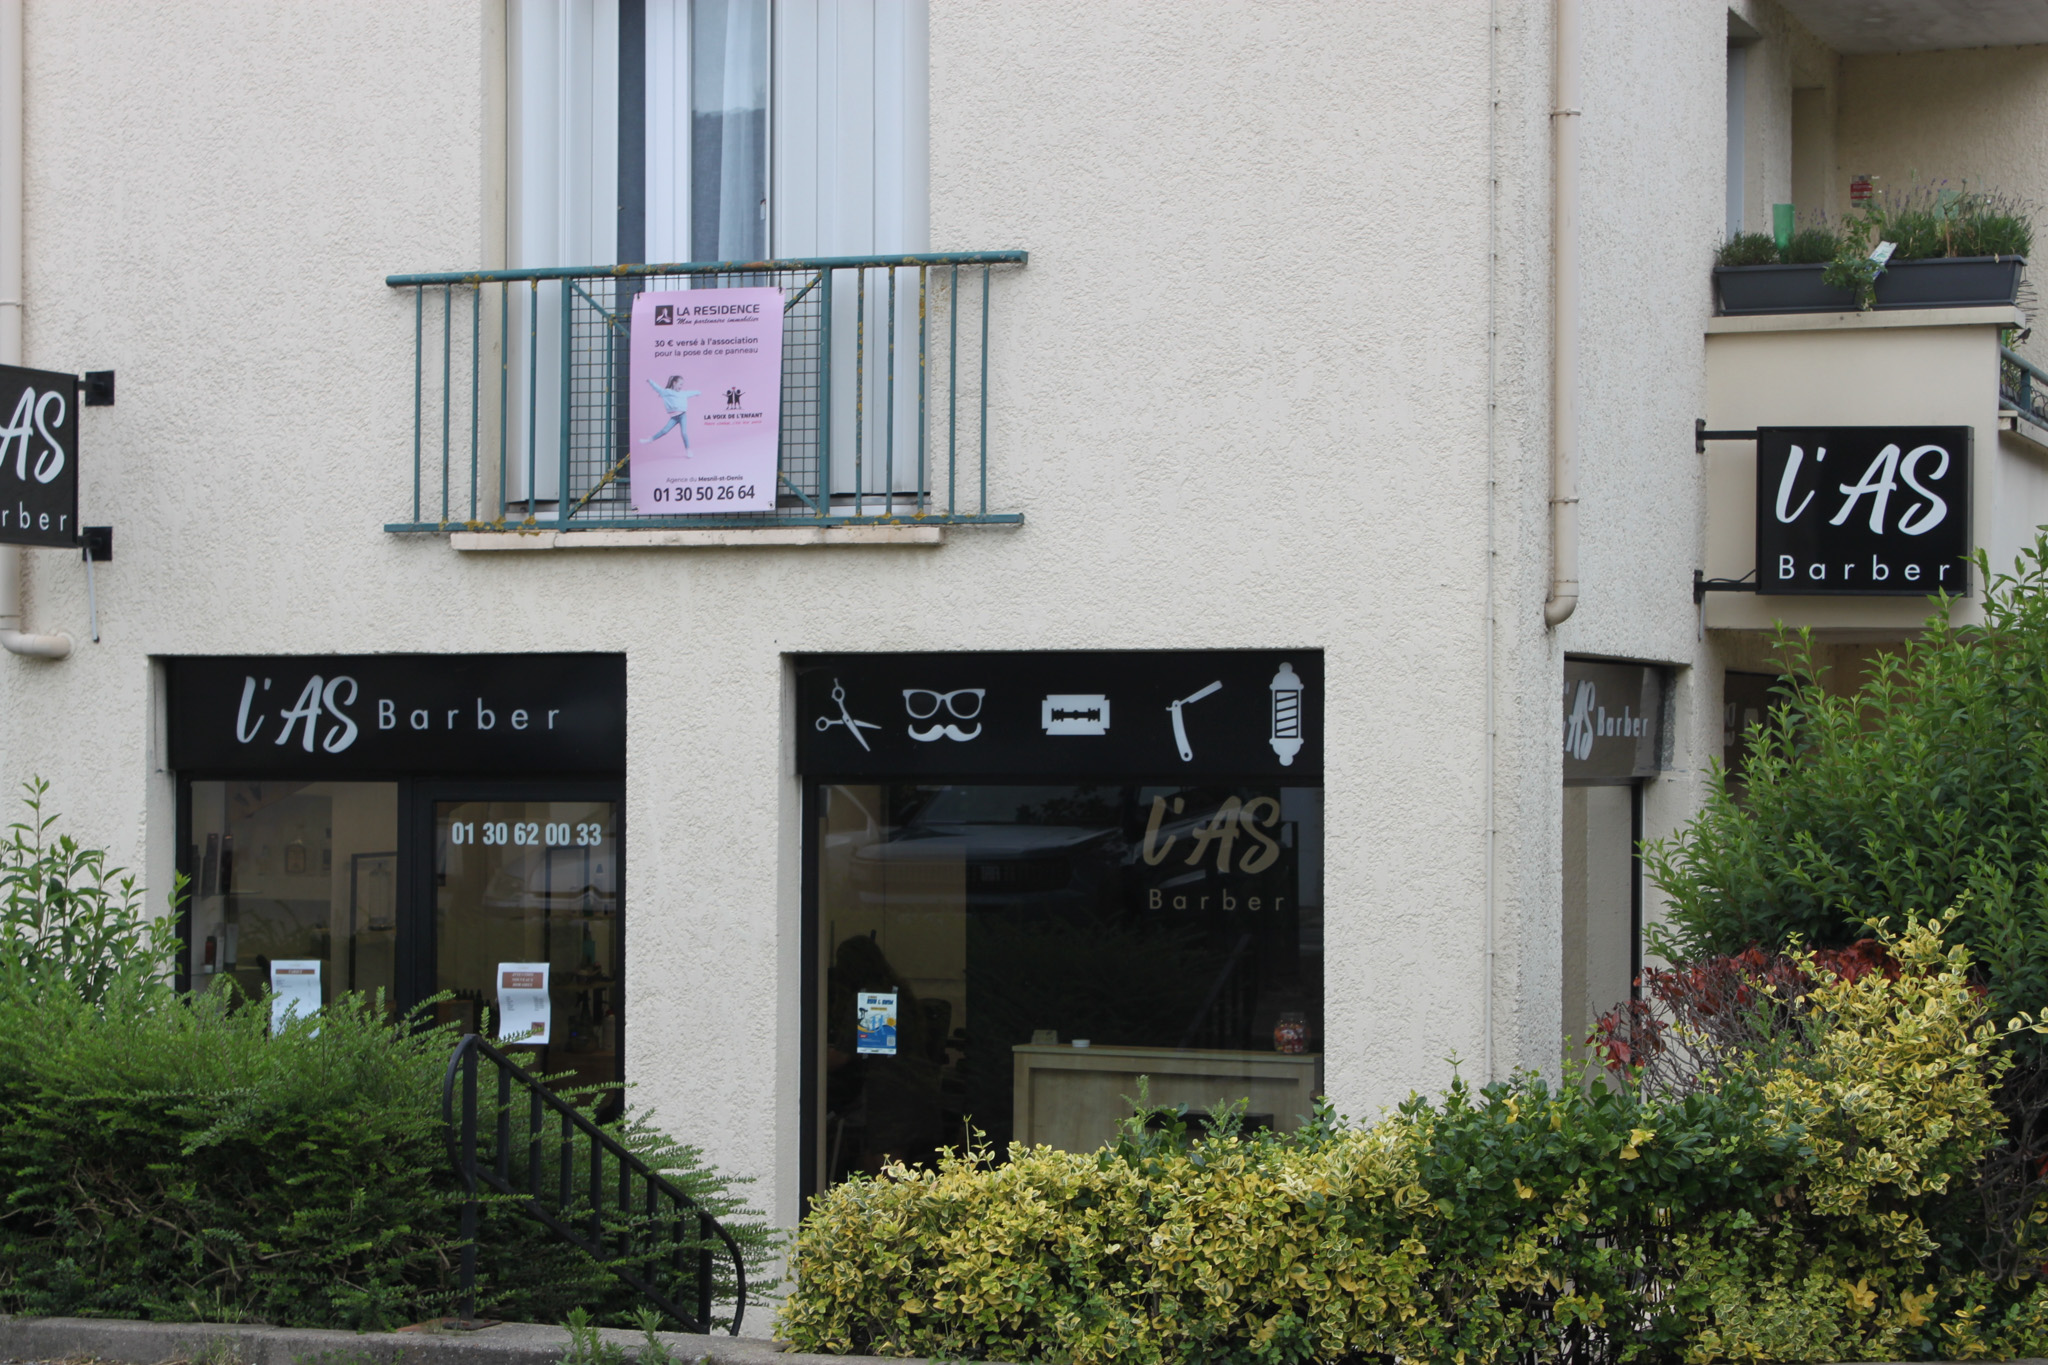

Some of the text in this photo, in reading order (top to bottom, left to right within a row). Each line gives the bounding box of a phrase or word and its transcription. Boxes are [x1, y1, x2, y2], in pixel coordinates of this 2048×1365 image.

[676, 304, 760, 316] LA RESIDENCE
[655, 350, 672, 358] pour
[683, 349, 701, 357] pose
[725, 347, 758, 356] panneau
[676, 338, 698, 346] versé
[707, 336, 758, 345] l'association
[0, 386, 65, 483] AS
[654, 485, 755, 502] 01 30 50 26 64
[2, 501, 67, 531] rber
[1779, 554, 1951, 581] Barber
[379, 698, 559, 730] Barber
[1597, 706, 1649, 737] Barber
[452, 822, 602, 847] 01 30 62 00 33
[1149, 888, 1286, 912] Barber
